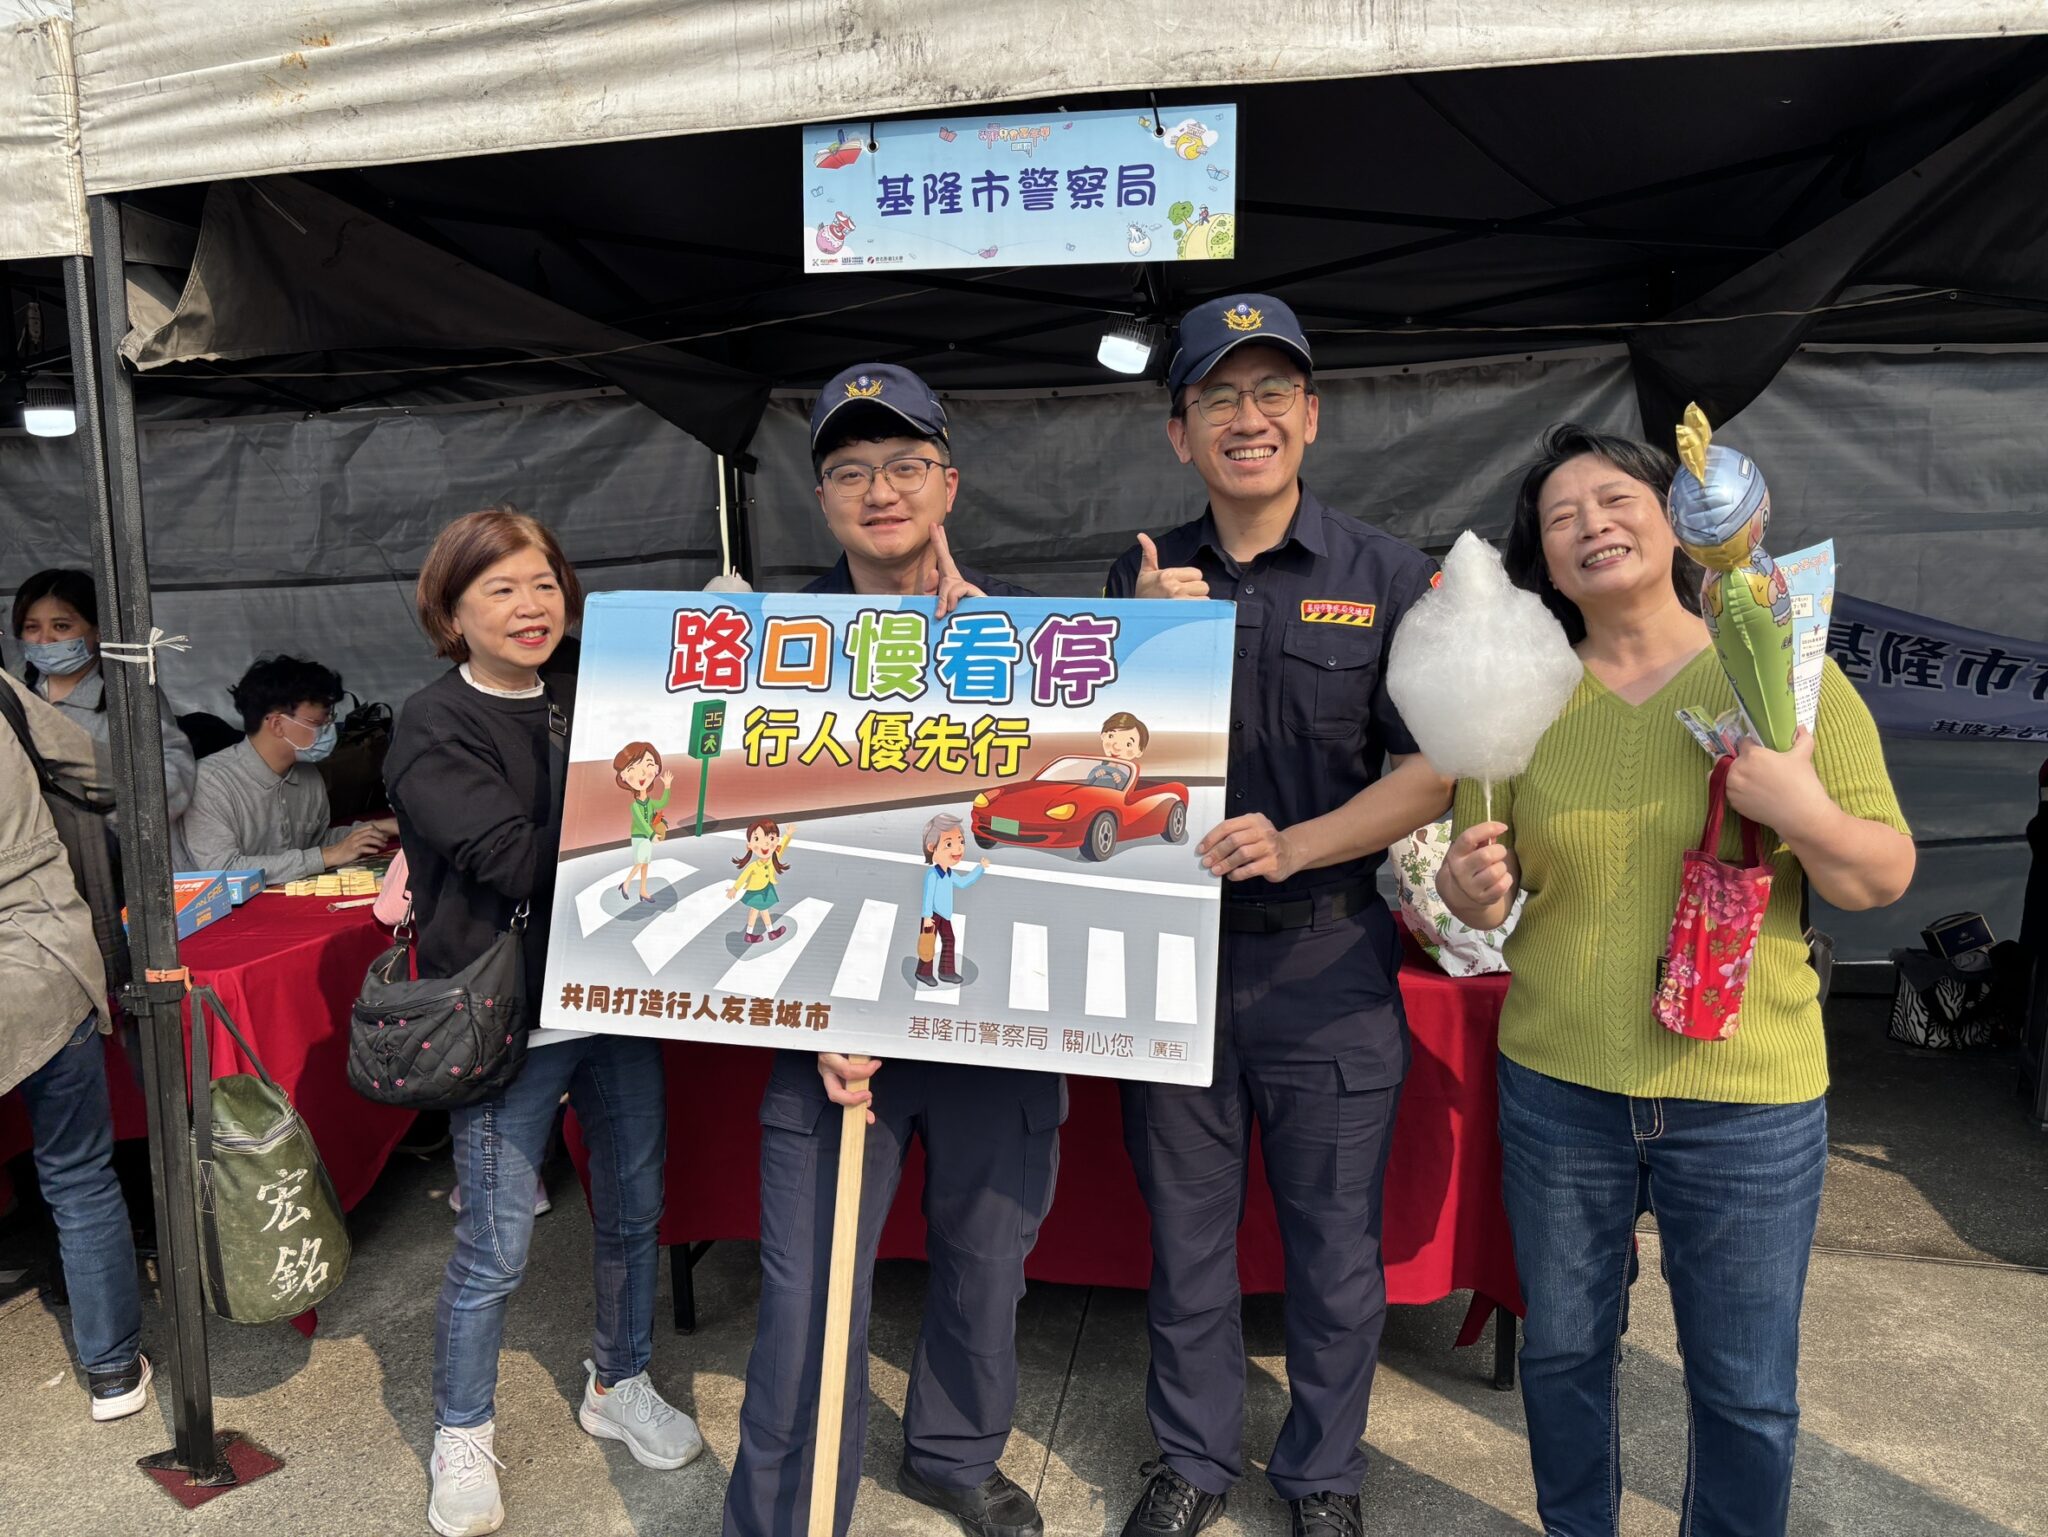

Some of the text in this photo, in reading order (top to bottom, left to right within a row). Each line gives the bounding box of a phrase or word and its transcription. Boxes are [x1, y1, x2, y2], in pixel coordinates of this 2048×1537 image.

[876, 163, 1157, 217] 基隆市警察局
[667, 607, 1119, 707] 路口慢看停
[704, 711, 723, 728] 25
[743, 706, 1031, 777] 行人優先行
[560, 983, 832, 1031] 共同打造行人友善城市
[908, 1016, 1184, 1058] 基隆市警察局 關心您 廣告
